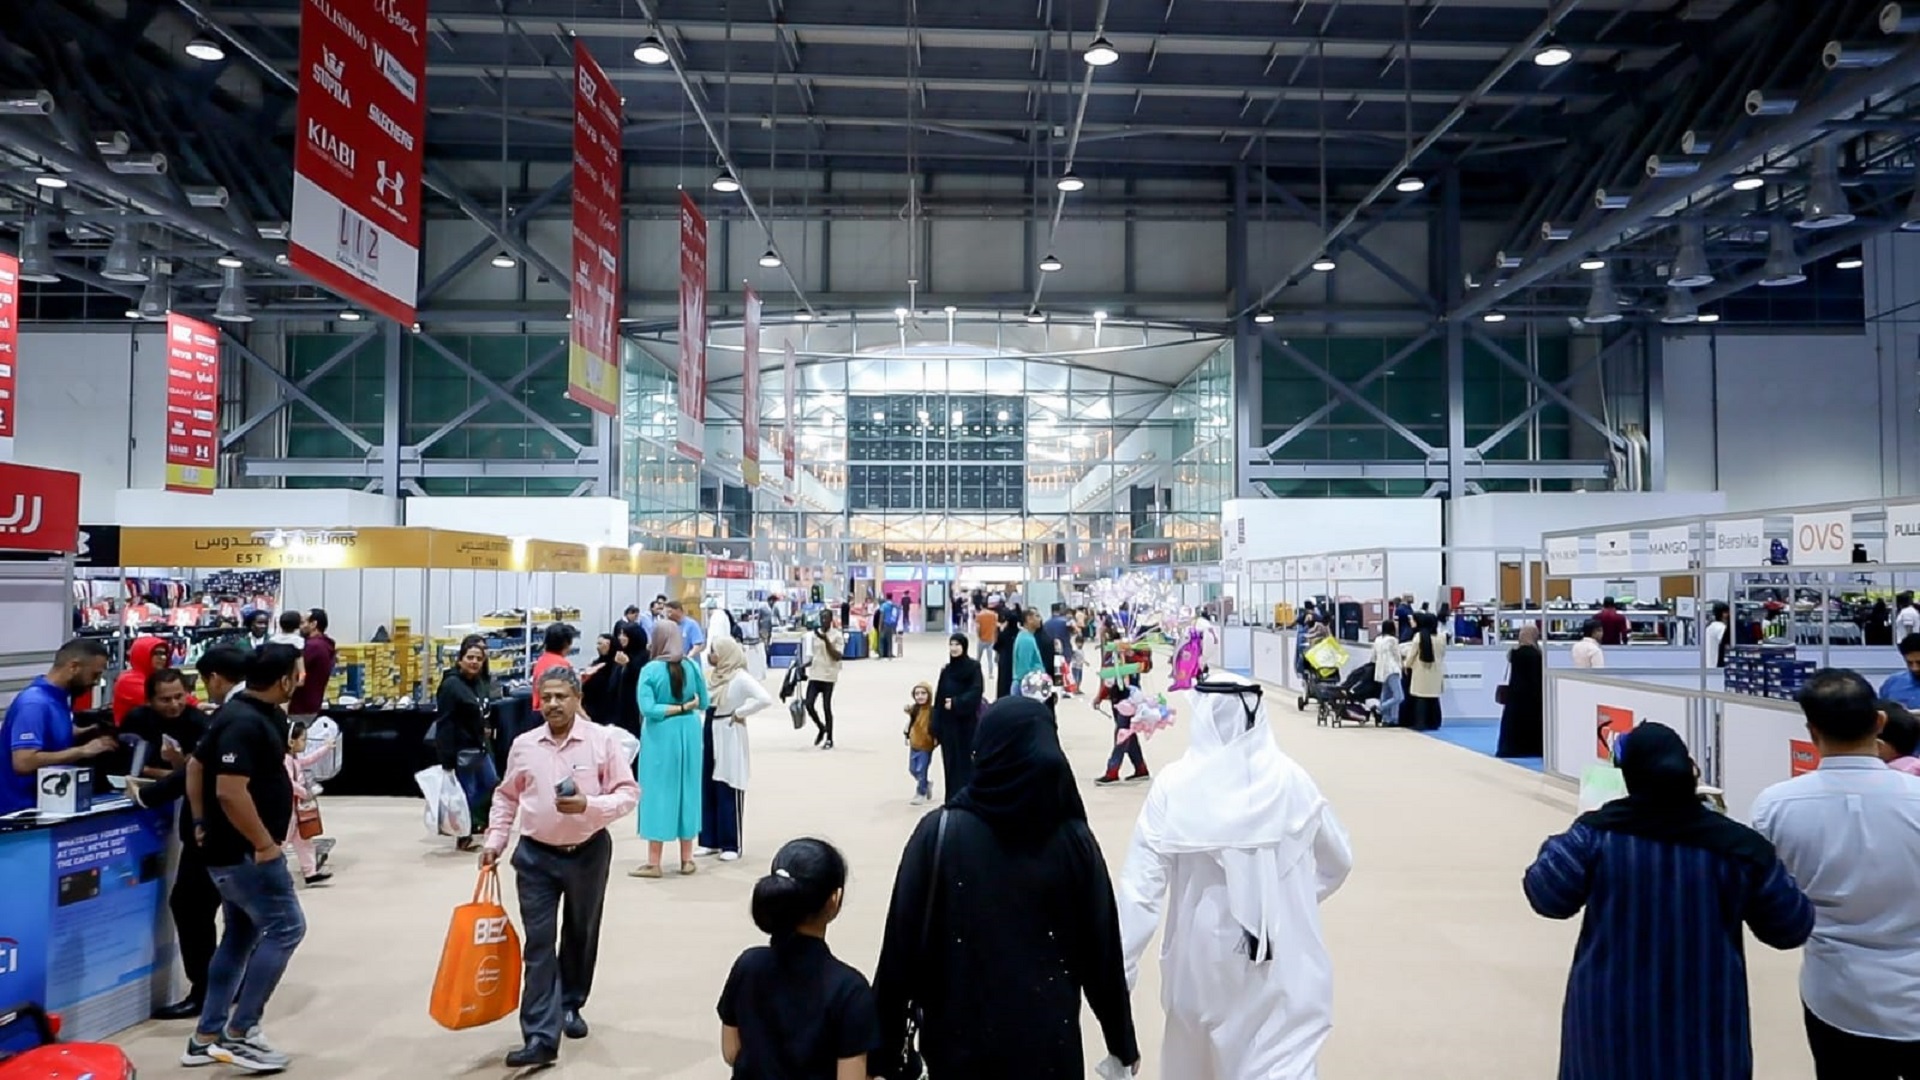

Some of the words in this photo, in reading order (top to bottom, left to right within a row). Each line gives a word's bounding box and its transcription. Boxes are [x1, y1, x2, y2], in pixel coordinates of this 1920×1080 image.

[312, 61, 352, 109] SUPRA
[367, 102, 414, 152] SKECHERS
[308, 117, 355, 170] KIABI
[1649, 540, 1688, 556] MANGO
[1718, 532, 1760, 550] Bershka
[1799, 522, 1844, 552] OVS
[474, 915, 508, 945] BEZ
